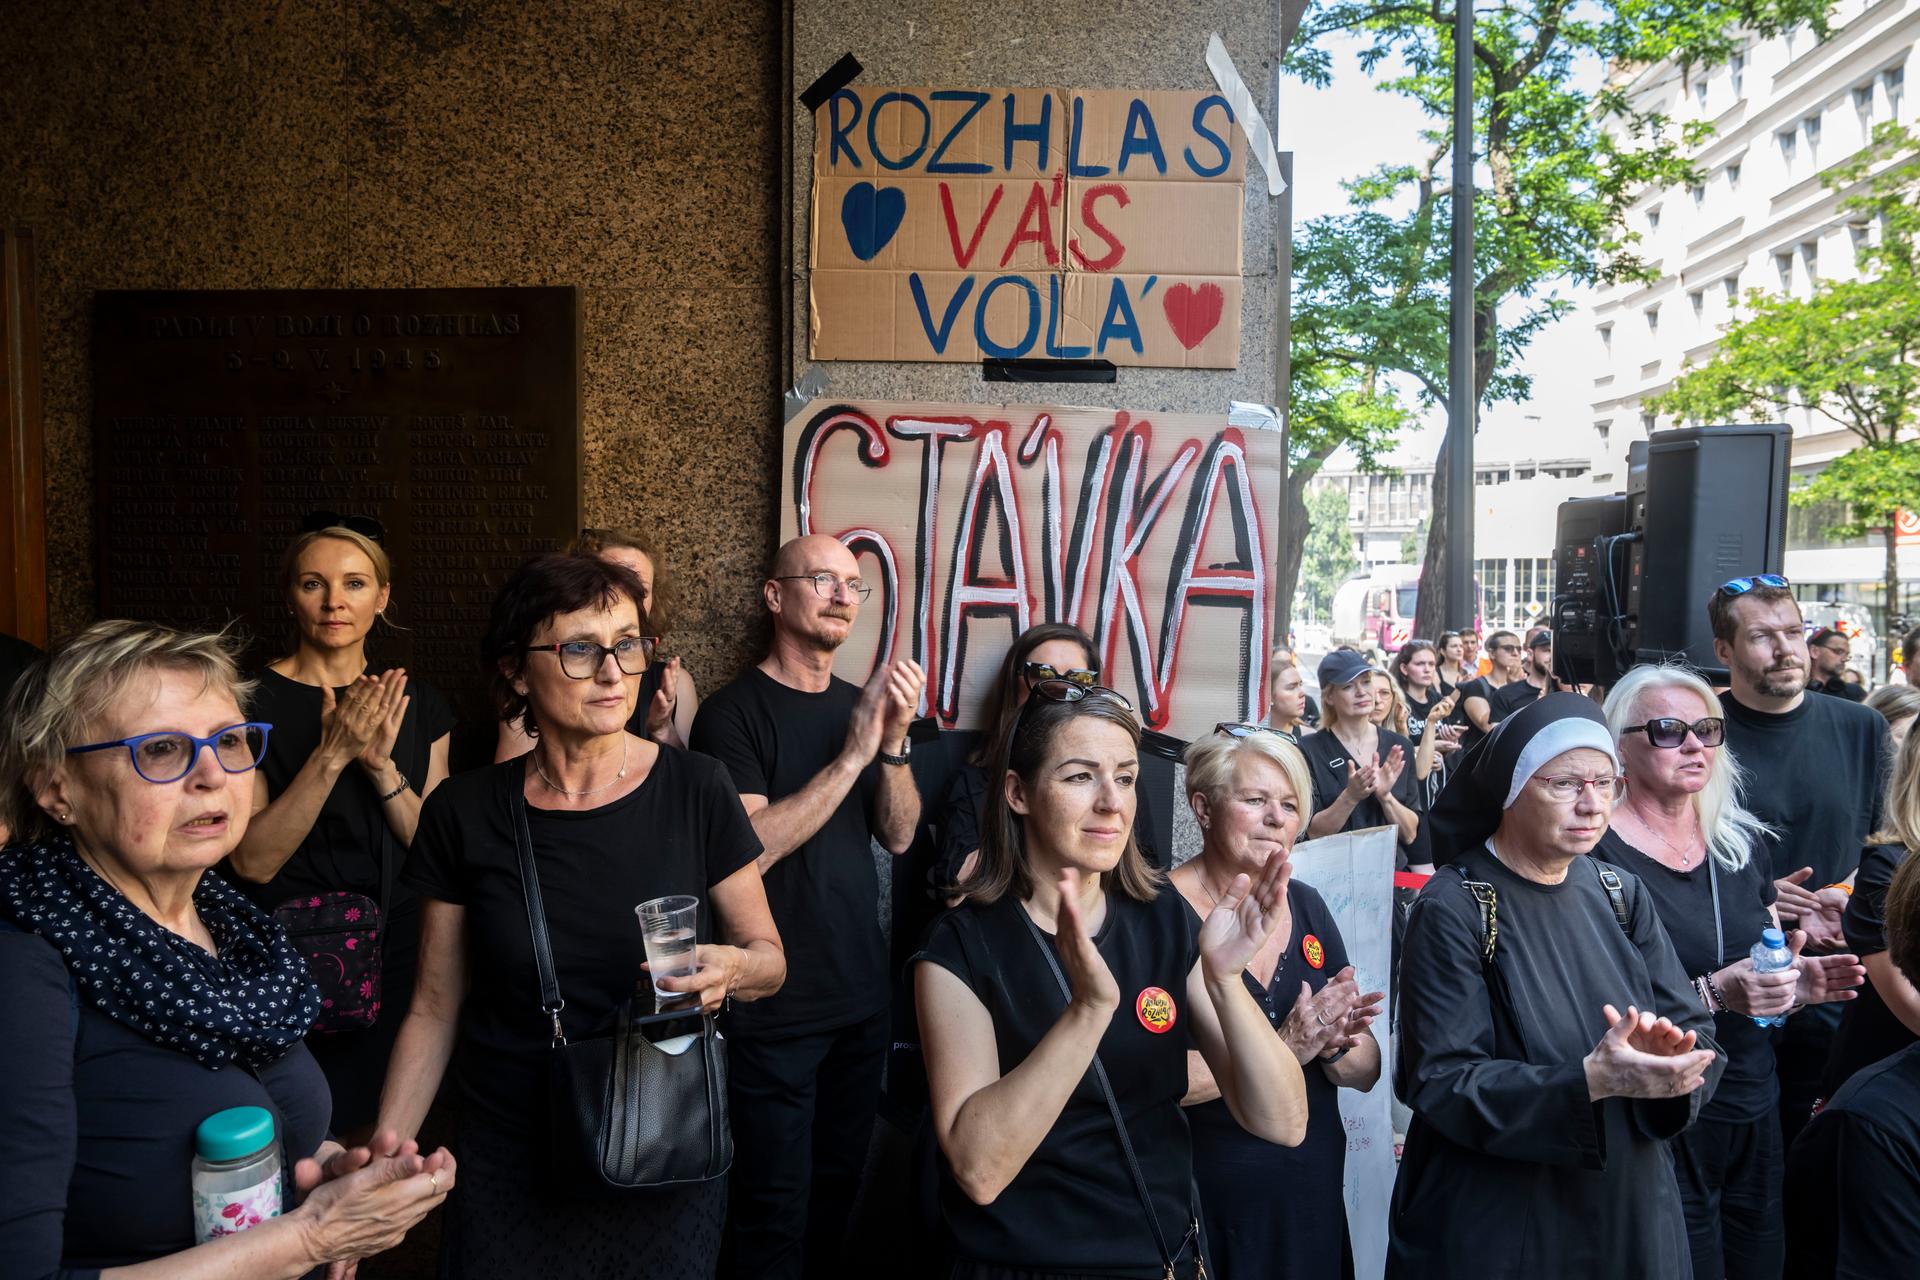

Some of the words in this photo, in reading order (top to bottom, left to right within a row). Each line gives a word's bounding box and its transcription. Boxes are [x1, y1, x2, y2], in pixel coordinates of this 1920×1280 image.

[829, 88, 1234, 178] ROZHLAS
[938, 168, 1131, 271] VÁS
[151, 313, 236, 337] PADLI
[244, 314, 265, 337] V
[275, 314, 344, 337] BOJI
[352, 314, 373, 336] O
[381, 314, 521, 337] ROZHLAS
[908, 272, 1157, 358] VOLÁ
[793, 404, 1270, 731] STÁVKA
